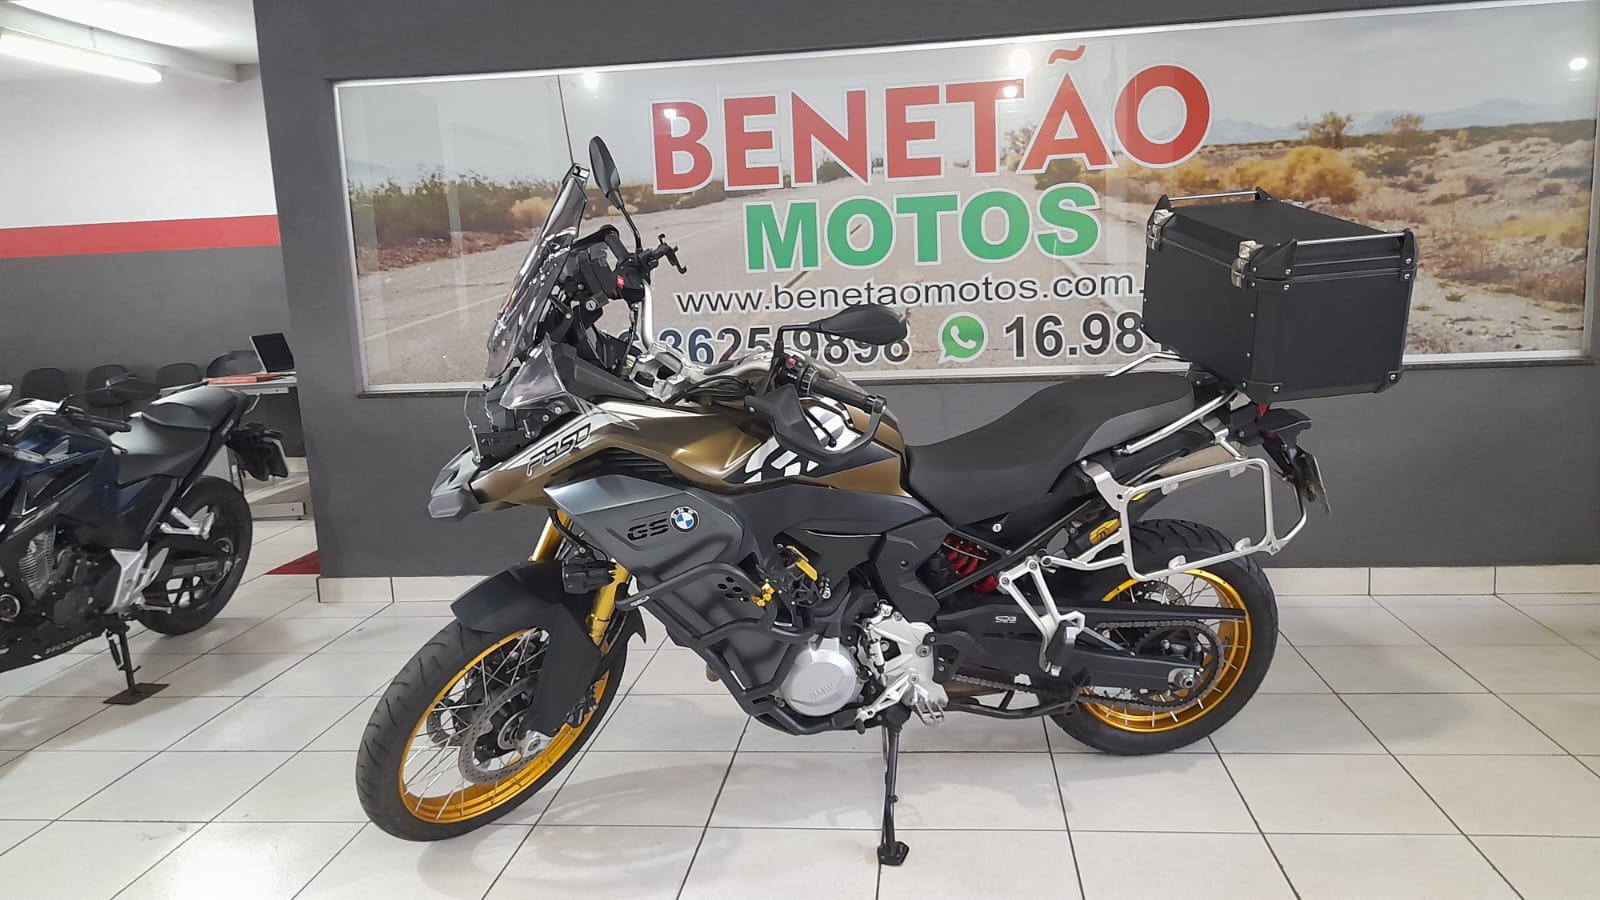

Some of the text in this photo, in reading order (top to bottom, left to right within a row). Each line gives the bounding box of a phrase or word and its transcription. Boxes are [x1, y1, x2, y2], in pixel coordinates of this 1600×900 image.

[651, 45, 1211, 193] BENETÃO
[745, 186, 1100, 270] MOTOS
[627, 518, 669, 541] GS
